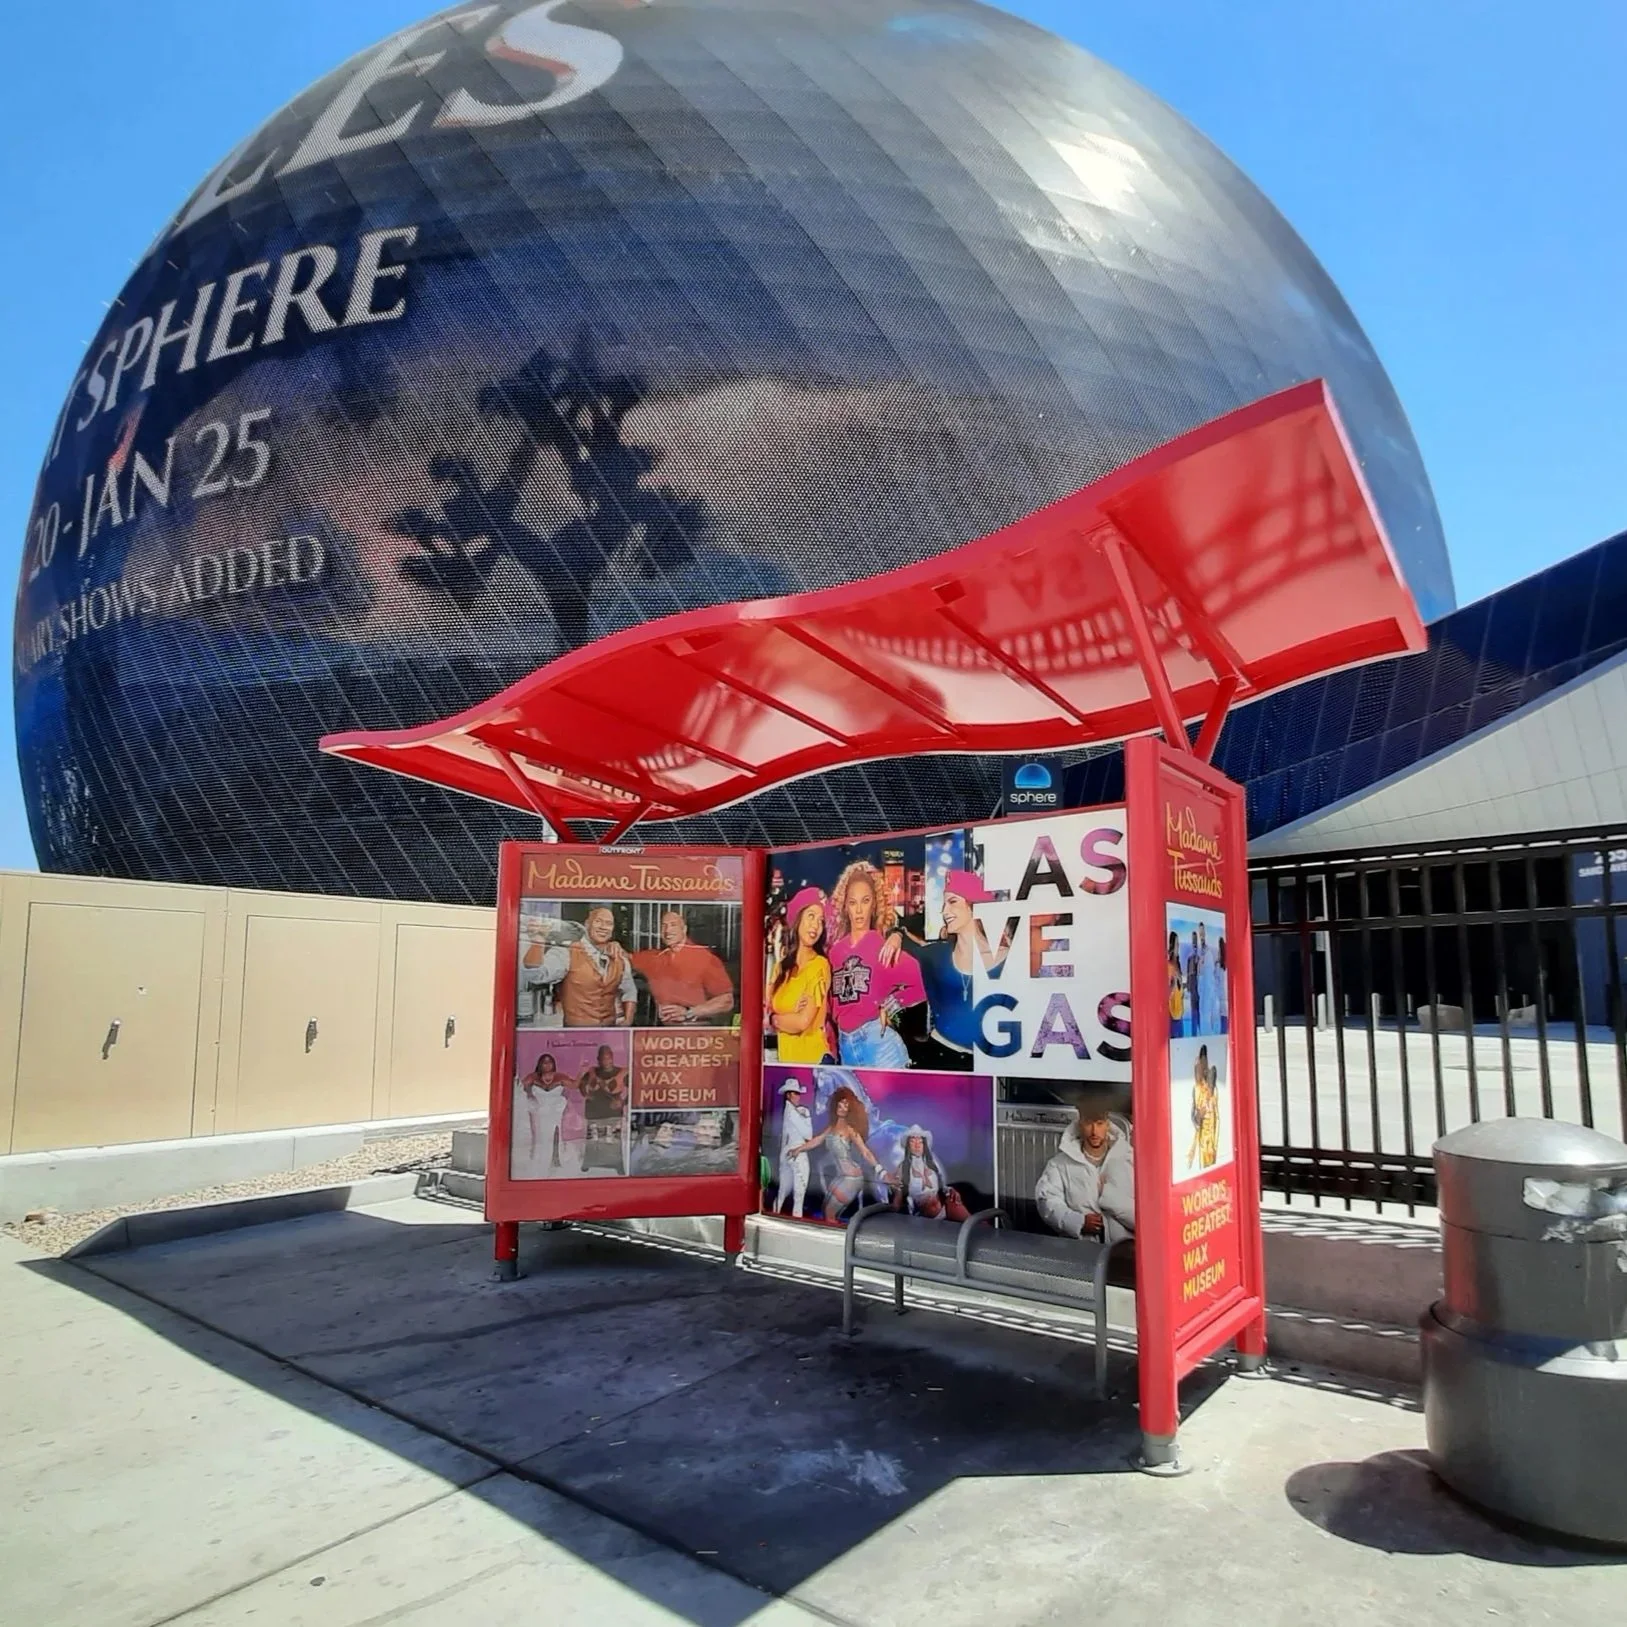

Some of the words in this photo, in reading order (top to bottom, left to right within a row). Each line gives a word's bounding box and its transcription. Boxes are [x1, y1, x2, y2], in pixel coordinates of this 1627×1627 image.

[77, 226, 419, 432] SPHERE
[192, 406, 272, 499] 25
[60, 578, 160, 646] SHOWS
[170, 533, 326, 602] ADDED
[1010, 791, 1057, 805] sphere
[1165, 802, 1222, 860] Madame
[528, 858, 635, 891] Madame
[630, 864, 735, 893] Tussauds
[973, 828, 1127, 904] LAS
[1166, 848, 1222, 899] Tussauds
[973, 912, 1074, 980] VE
[641, 1036, 725, 1050] WORLD'S
[972, 992, 1132, 1062] GAS
[640, 1071, 682, 1085] WAX
[641, 1054, 733, 1068] GREATEST
[640, 1088, 717, 1102] MUSEUM
[1182, 1179, 1227, 1217] WORLD'S
[1183, 1203, 1233, 1246] GREATEST
[1183, 1241, 1208, 1273] WAX
[1183, 1258, 1226, 1304] MUSEUM
